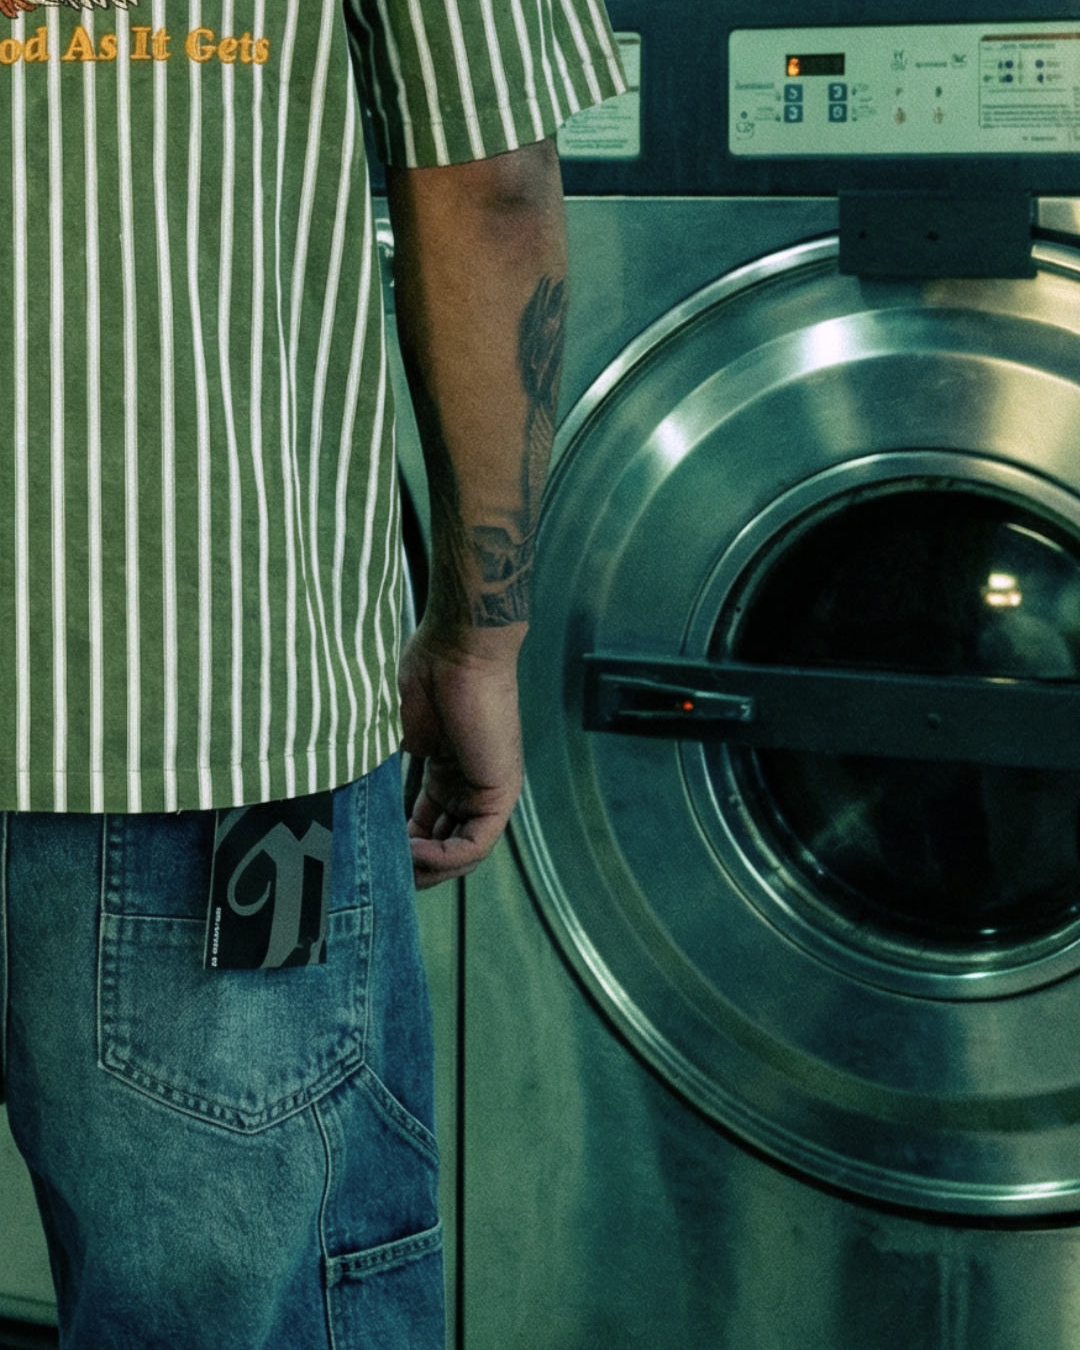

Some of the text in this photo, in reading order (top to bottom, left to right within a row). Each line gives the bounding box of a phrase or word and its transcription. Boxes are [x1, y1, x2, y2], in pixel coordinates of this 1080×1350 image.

[60, 25, 119, 62] As
[129, 25, 172, 62] It
[184, 26, 270, 65] Gets
